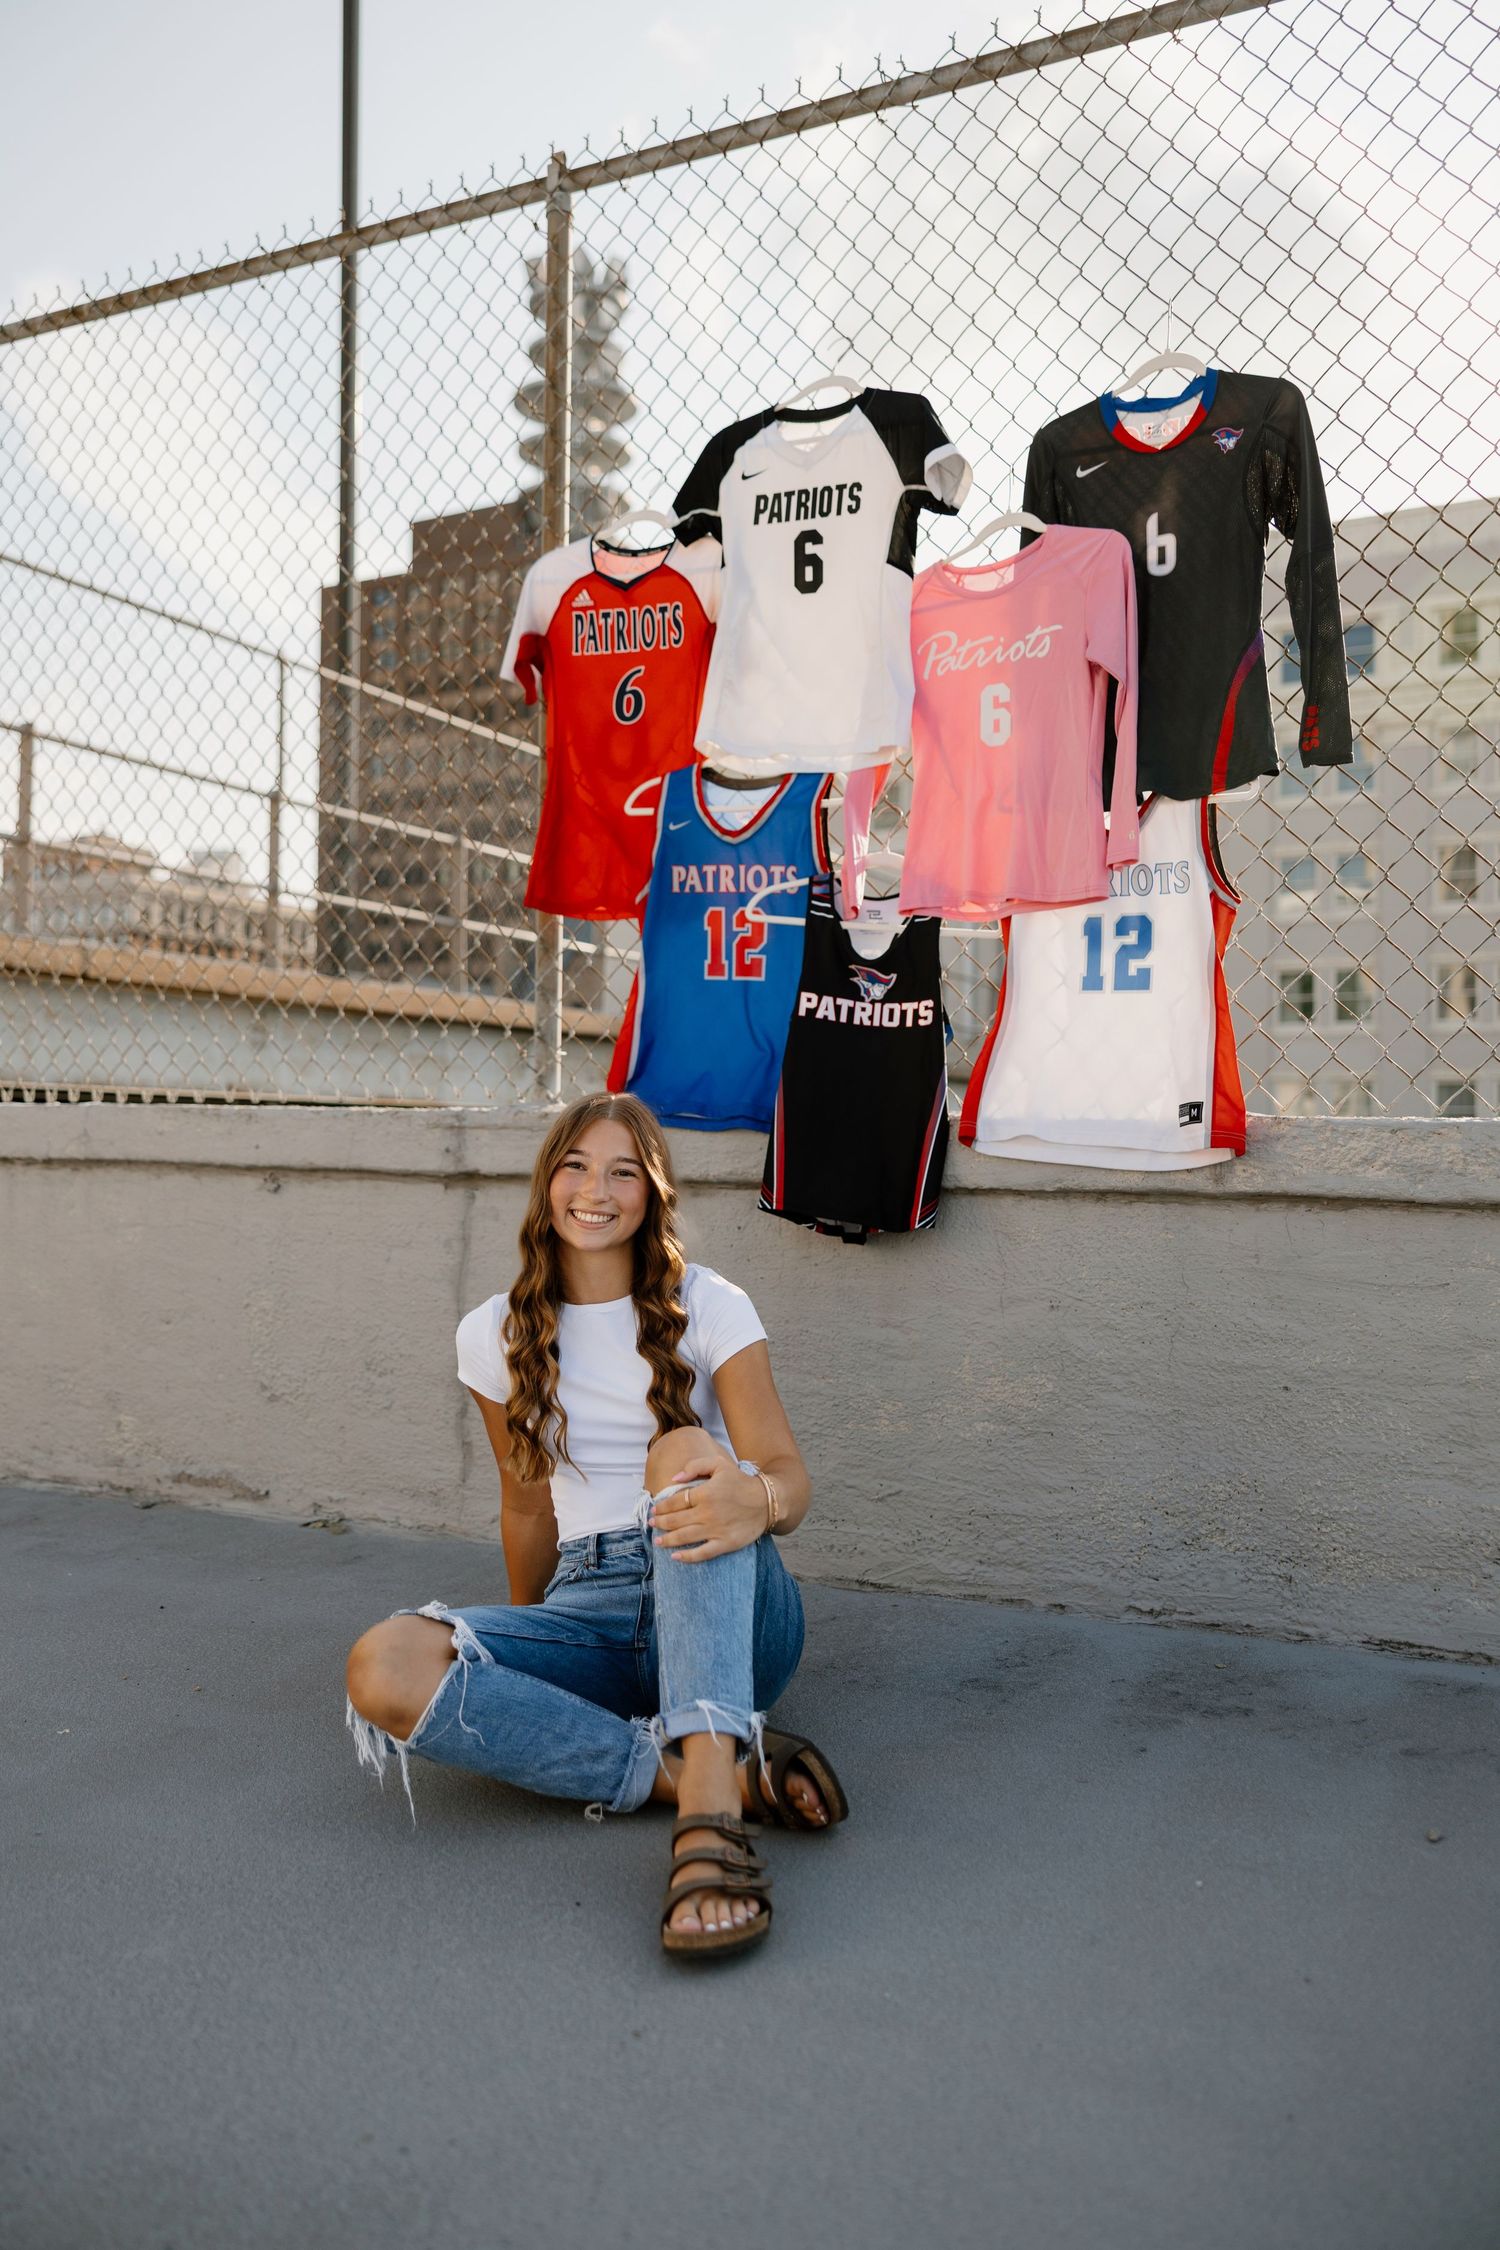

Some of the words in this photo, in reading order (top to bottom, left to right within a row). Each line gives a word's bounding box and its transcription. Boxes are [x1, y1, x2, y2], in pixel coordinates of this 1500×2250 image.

[753, 481, 863, 526] PATRIOTS
[793, 529, 824, 595] 6
[1145, 511, 1177, 577] 6
[571, 601, 685, 656] PATRIOTS
[916, 624, 1063, 681] Patriots
[612, 665, 646, 725] 6
[979, 682, 1011, 747] 6
[671, 864, 800, 895] PATRIOTS
[703, 906, 768, 982] 12
[1080, 912, 1154, 993] 12
[798, 990, 935, 1029] PATRIOTS
